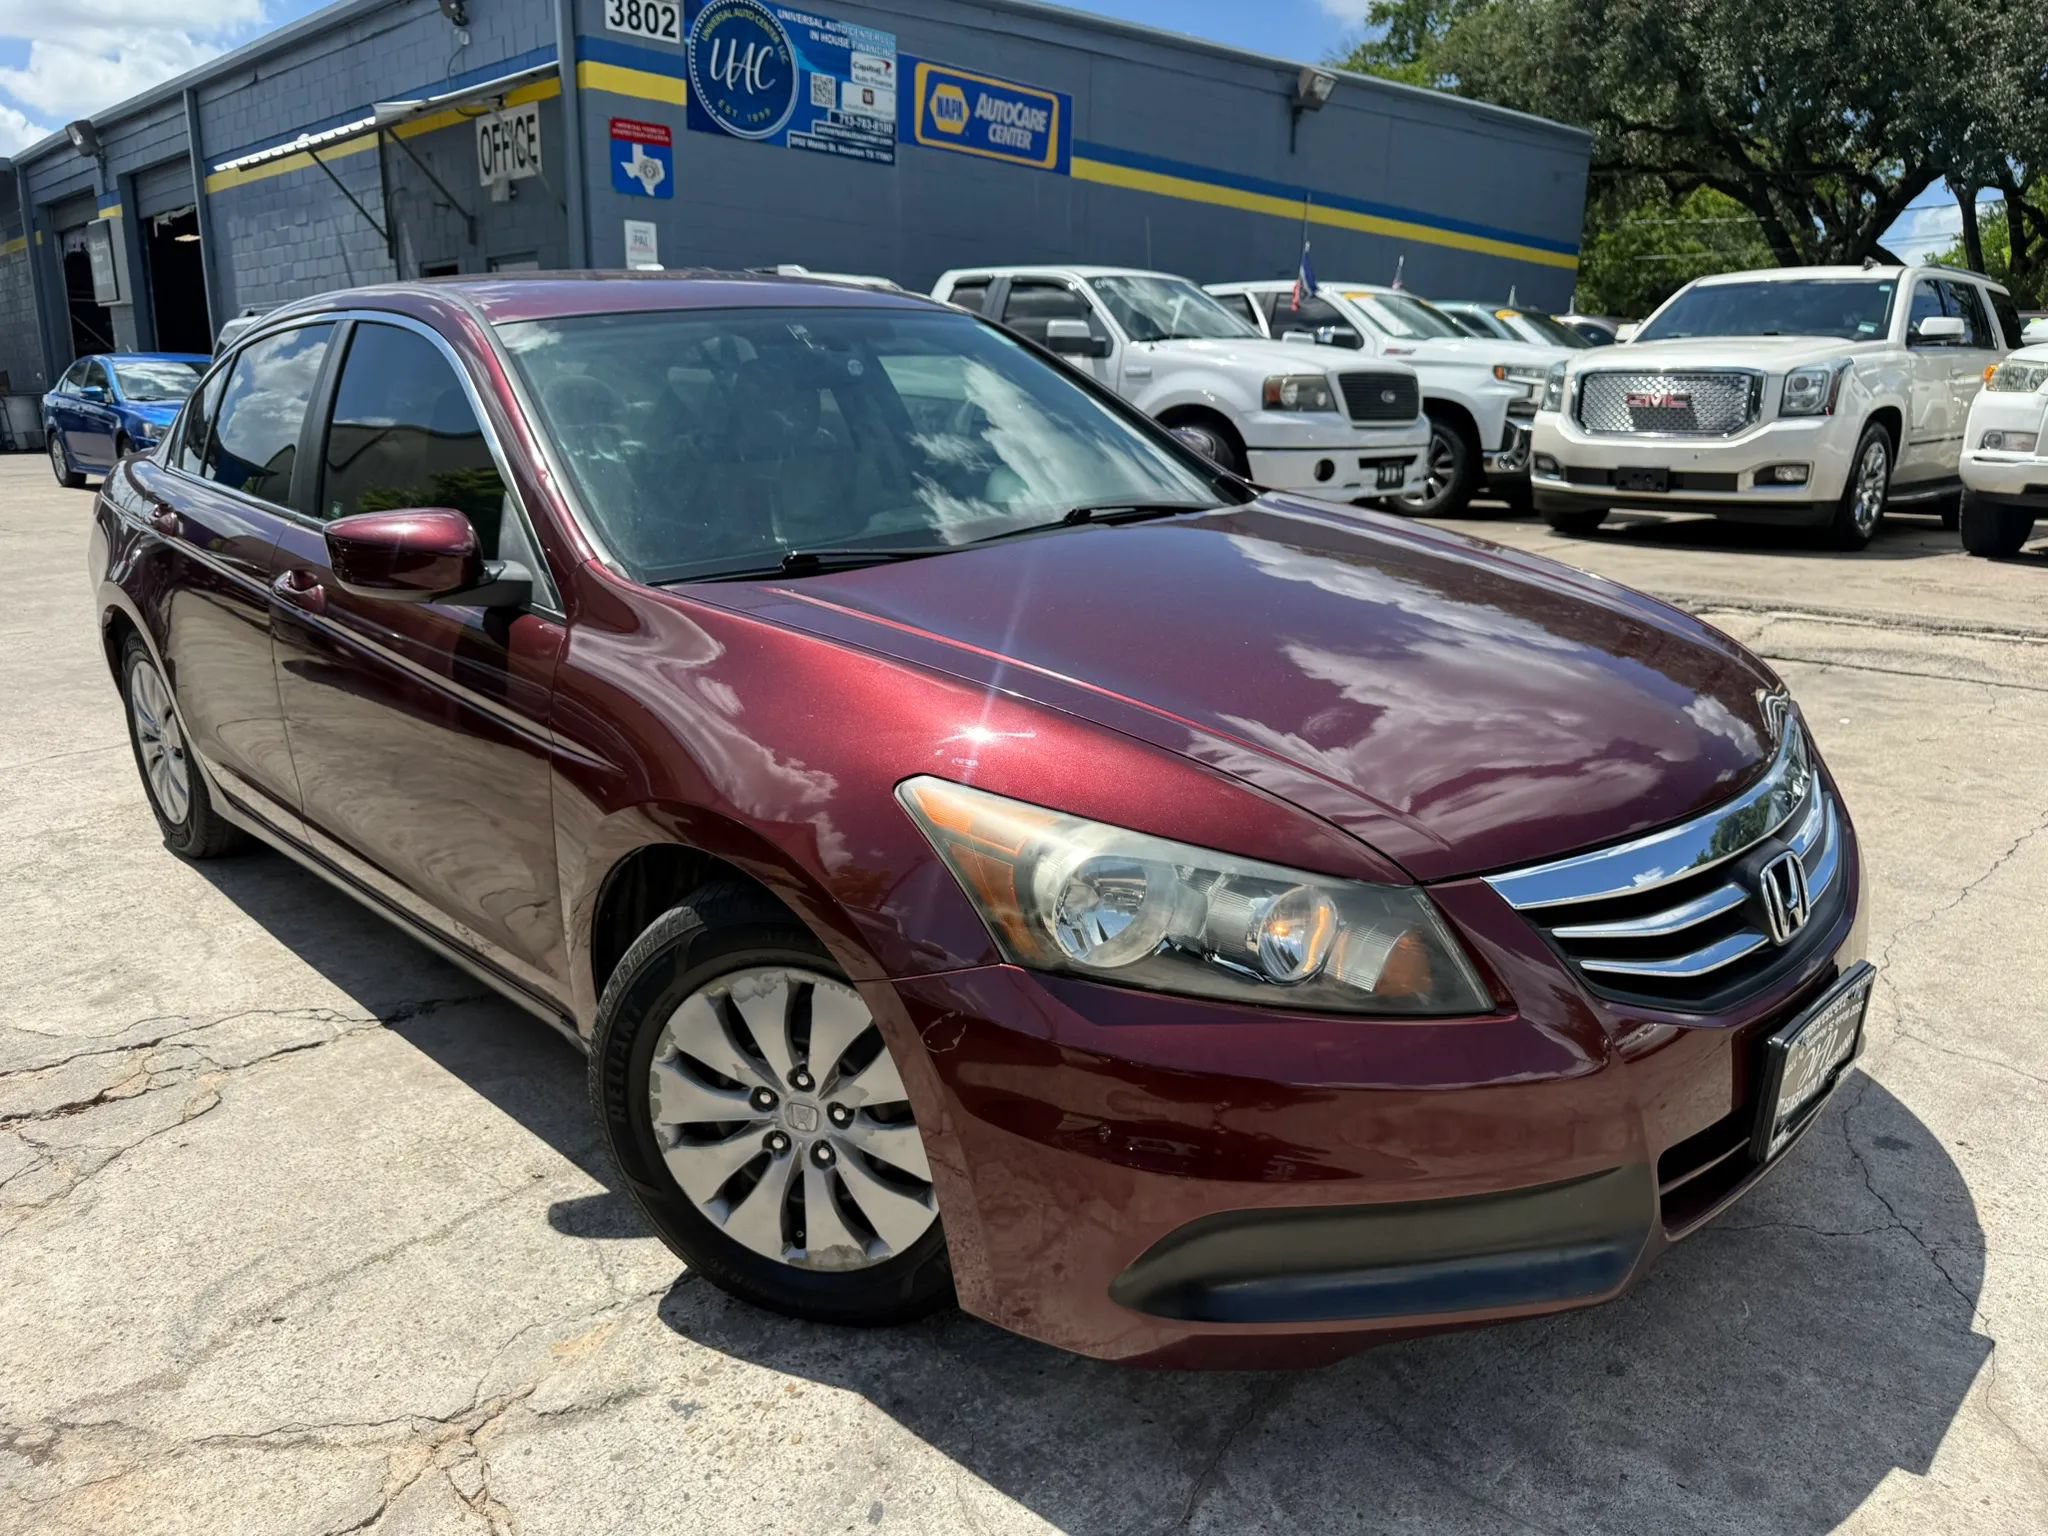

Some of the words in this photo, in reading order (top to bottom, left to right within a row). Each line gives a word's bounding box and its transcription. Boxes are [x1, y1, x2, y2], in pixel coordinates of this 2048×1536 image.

[610, 0, 677, 38] 3802
[777, 9, 824, 29] UNIVERSAL
[824, 21, 848, 34] AUTO
[820, 33, 851, 49] HOUSE
[936, 95, 964, 122] NAPA
[480, 114, 538, 176] OFFICE
[988, 123, 1032, 150] CENTER
[1626, 393, 1688, 408] GMC
